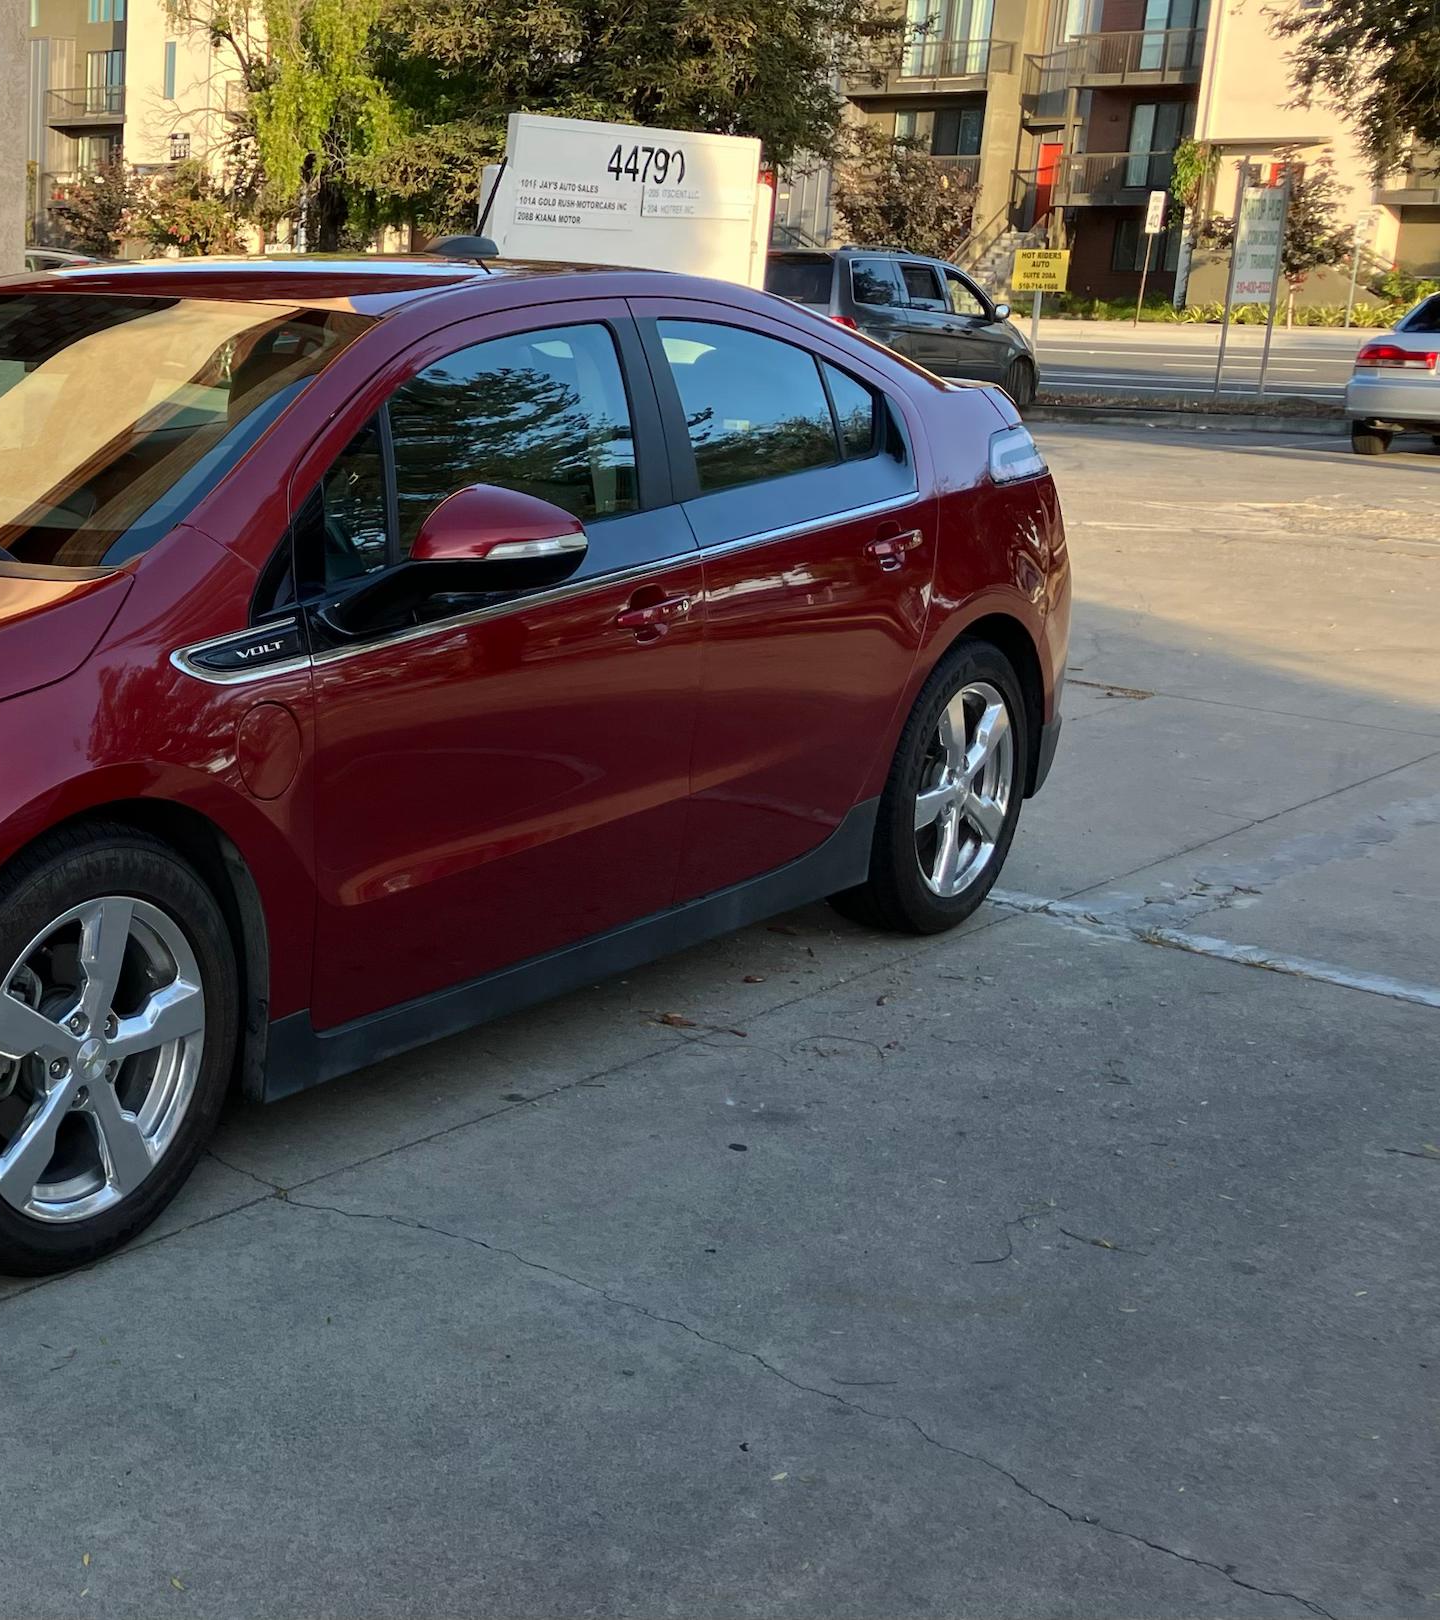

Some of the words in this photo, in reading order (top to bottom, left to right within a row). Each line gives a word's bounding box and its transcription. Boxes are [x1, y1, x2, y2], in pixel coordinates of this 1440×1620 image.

[539, 180, 558, 190] JAY'S
[559, 183, 576, 192] AUTO
[577, 184, 599, 194] SALES
[520, 196, 536, 205] 101A
[538, 198, 556, 207] GOLD
[617, 203, 627, 211] INC
[535, 213, 556, 223] KIANA
[558, 215, 581, 224] MOTOR
[235, 640, 284, 658] VOLT
